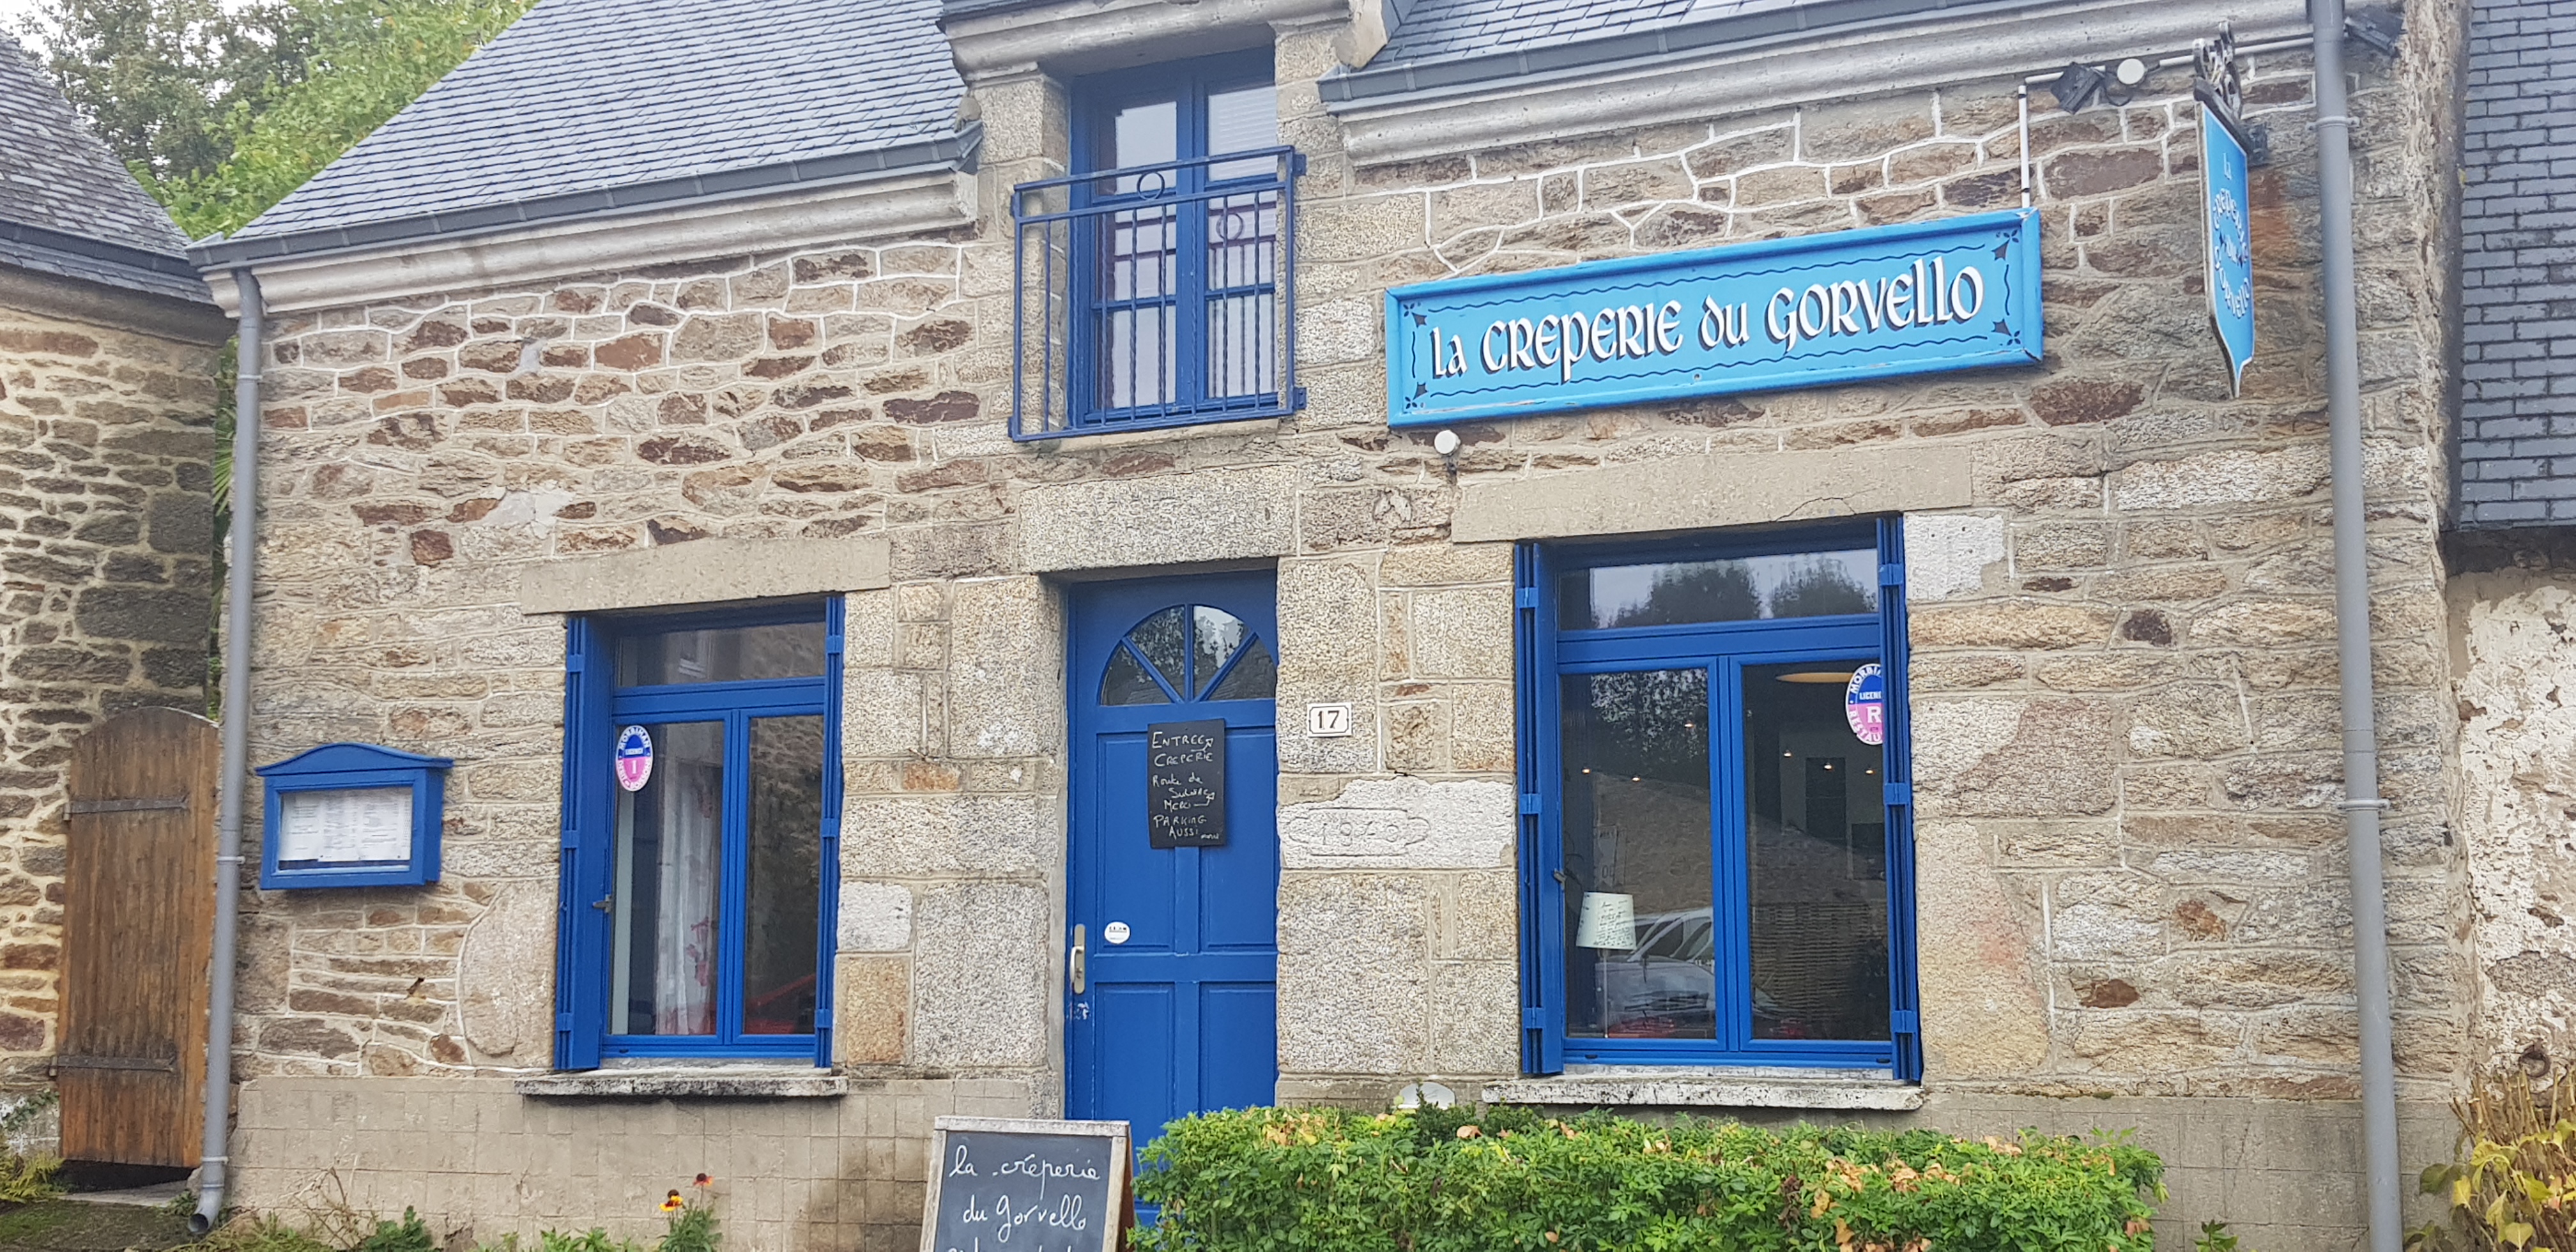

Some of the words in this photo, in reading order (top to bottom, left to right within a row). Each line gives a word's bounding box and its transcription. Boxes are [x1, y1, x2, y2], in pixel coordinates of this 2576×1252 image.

[1480, 299, 1685, 386] CREPERIE
[1698, 294, 1750, 351] du
[1765, 256, 1984, 356] GORVELLO
[1850, 666, 1882, 694] MORBI
[1317, 710, 1340, 729] 17
[1849, 710, 1883, 742] RESTAU
[1866, 705, 1882, 723] R
[1188, 772, 1203, 784] de
[949, 1145, 977, 1177] la
[963, 1194, 988, 1224] du
